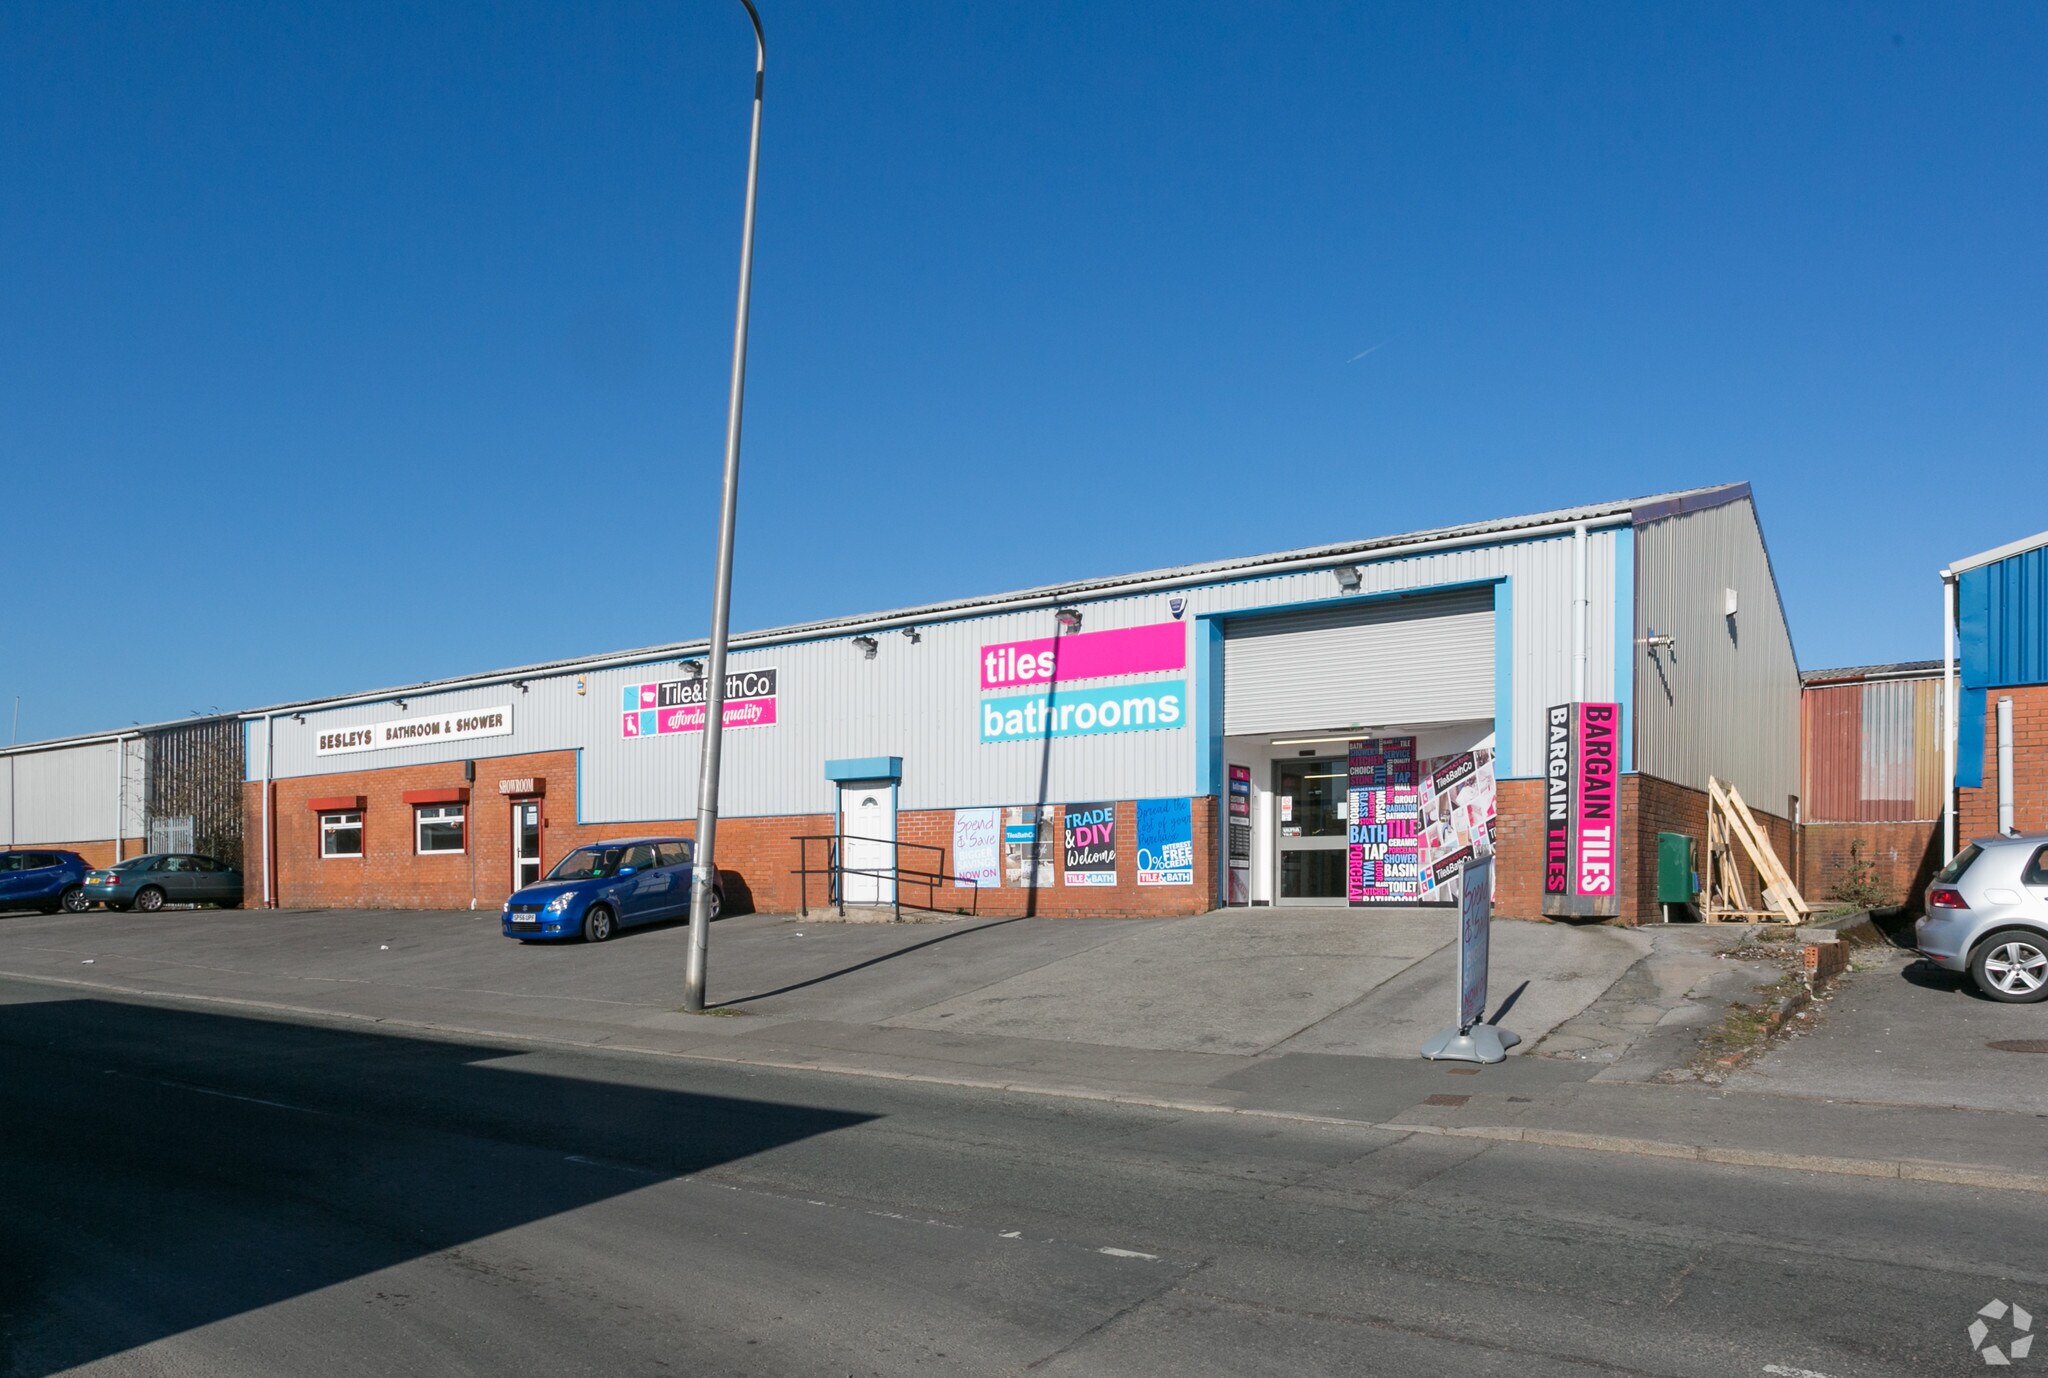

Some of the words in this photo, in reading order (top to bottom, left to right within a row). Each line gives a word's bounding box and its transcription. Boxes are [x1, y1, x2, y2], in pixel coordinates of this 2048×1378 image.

[985, 647, 1057, 684] tiles
[661, 673, 770, 705] Tile&thCo
[722, 703, 763, 725] quality
[984, 695, 1180, 737] bathrooms
[320, 729, 373, 750] BESLEYS
[386, 721, 440, 741] BATHROOM
[444, 720, 451, 734] &
[456, 713, 503, 731] SHOWER
[1350, 755, 1383, 766] KITCHEN
[1384, 750, 1410, 759] SERVICE
[1549, 706, 1567, 820] BARGAIN
[1584, 706, 1612, 819] BARGAIN
[1350, 766, 1374, 775] CHOICE
[1375, 764, 1386, 784] TILE
[1394, 772, 1411, 783] TAP
[1435, 761, 1473, 789] Tile&BathCo
[499, 778, 534, 794] SHOWROOM
[1350, 792, 1360, 825] MIRROR
[1360, 792, 1369, 817] GLASS
[1376, 791, 1386, 824] MOSAIC
[1386, 804, 1417, 812] RADIATOR
[1394, 795, 1417, 804] GROUT
[957, 809, 995, 840] Spend
[1064, 807, 1114, 829] TRADE
[1386, 812, 1417, 820] BATHROOM
[1065, 829, 1075, 849] &
[1075, 822, 1114, 848] DIY
[1350, 825, 1387, 844] BATH
[1386, 820, 1417, 838] TILE
[969, 832, 996, 848] Save
[1162, 841, 1192, 851] INTEREST
[1388, 838, 1417, 847] CERAMIC
[959, 848, 992, 861] BIGGER
[1067, 846, 1117, 867] Welcome
[1163, 847, 1193, 862] FREE
[1363, 844, 1388, 860] TAP
[1384, 854, 1417, 864] SHOWER
[1547, 825, 1566, 892] TILES
[1581, 825, 1610, 892] TILES
[1165, 858, 1193, 869] CREDIT
[1375, 860, 1383, 881] FLOOR
[1384, 864, 1417, 877] BASIN
[959, 869, 981, 880] NOW
[982, 868, 997, 878] ON
[1363, 861, 1375, 886] WALL
[1363, 887, 1389, 896] KITCHEN
[1388, 881, 1417, 893] TOILET
